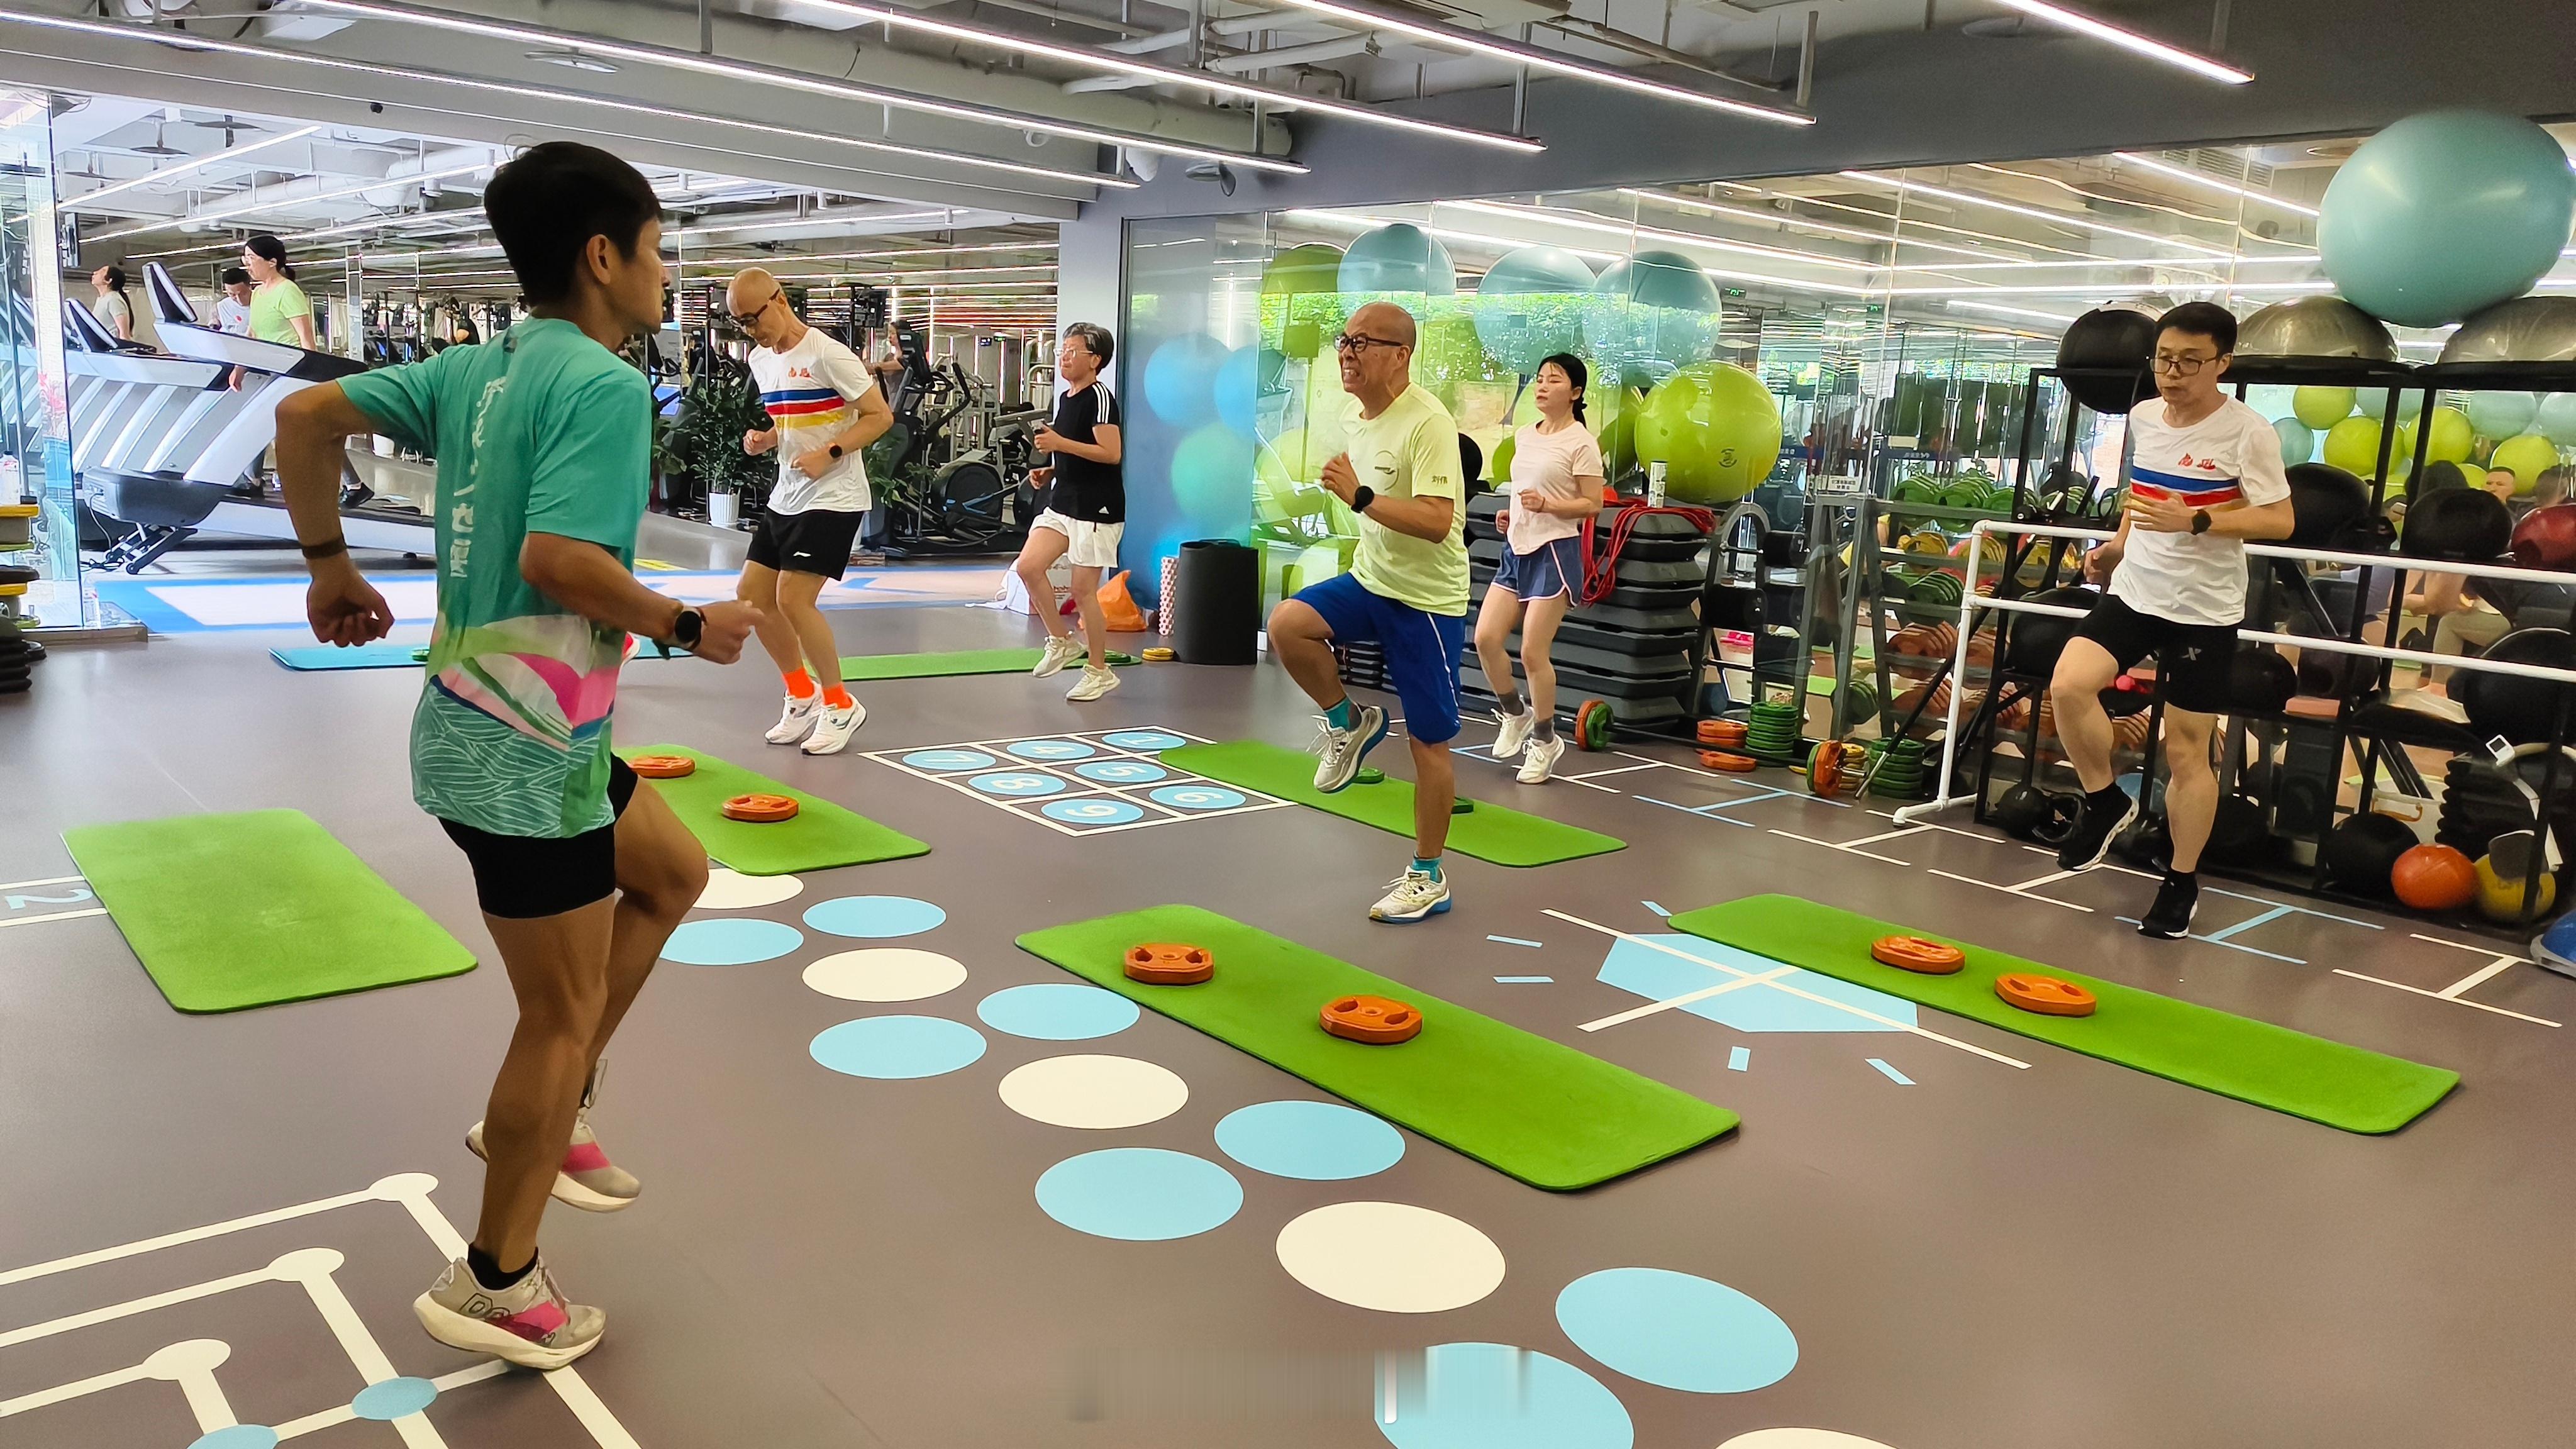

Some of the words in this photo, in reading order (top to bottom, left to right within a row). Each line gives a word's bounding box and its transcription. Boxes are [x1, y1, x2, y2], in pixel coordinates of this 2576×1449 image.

[1031, 745, 1076, 755] 4
[923, 753, 978, 762] 7
[1097, 765, 1146, 777] 5
[990, 777, 1043, 790] 8
[1174, 792, 1224, 803] 6
[1064, 804, 1118, 817] 9
[4, 888, 94, 910] 2
